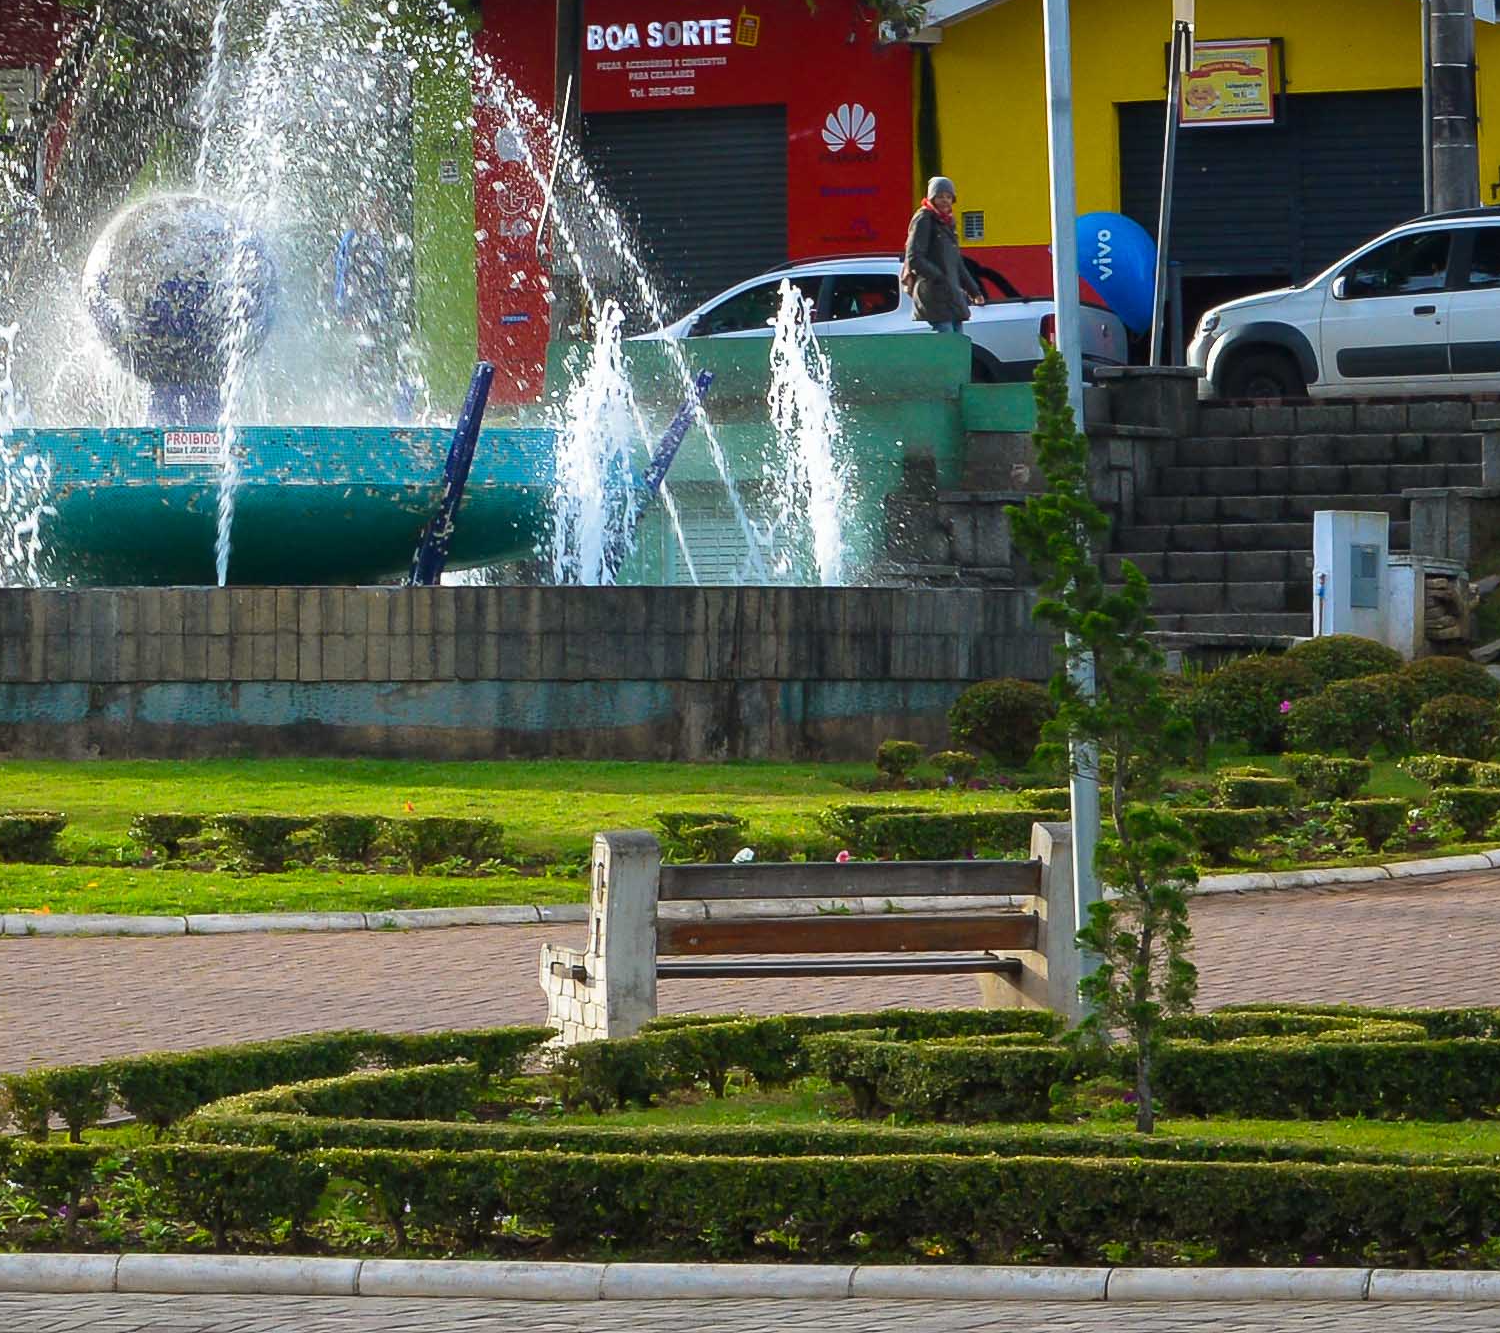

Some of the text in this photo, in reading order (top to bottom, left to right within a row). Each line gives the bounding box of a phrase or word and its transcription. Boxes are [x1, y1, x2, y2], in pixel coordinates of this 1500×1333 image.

[586, 18, 732, 51] BOA SORTE
[1092, 229, 1113, 281] vivo
[166, 433, 220, 445] PROIBIDO
